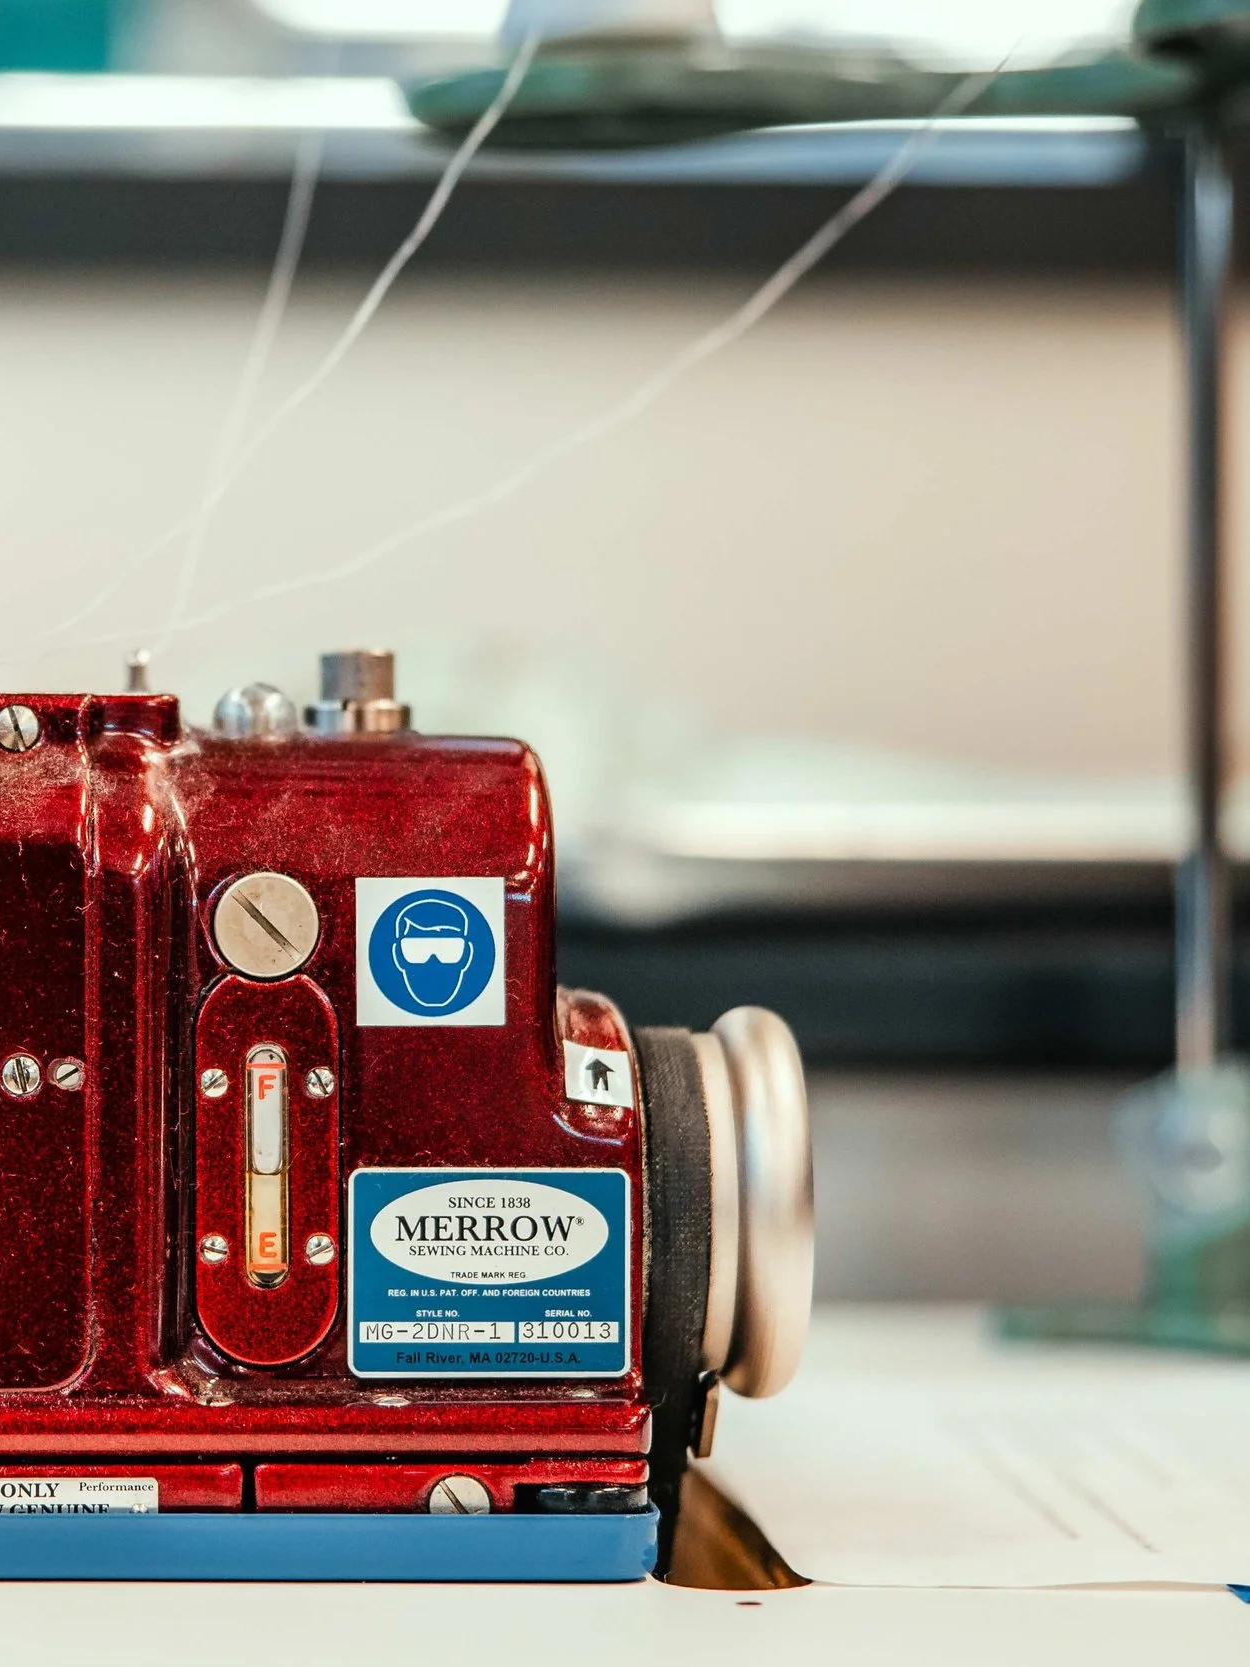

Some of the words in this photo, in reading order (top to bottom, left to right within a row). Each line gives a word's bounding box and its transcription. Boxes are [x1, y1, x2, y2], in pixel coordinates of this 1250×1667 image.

[258, 1074, 277, 1100] F
[448, 1197, 495, 1208] SINCE
[500, 1197, 531, 1208] 1838
[258, 1232, 278, 1258] E
[409, 1245, 466, 1256] SEWING
[470, 1245, 540, 1256] MACHINE
[544, 1245, 569, 1256] CO.
[450, 1271, 479, 1279] TRADE
[481, 1271, 505, 1279] MARK
[508, 1271, 528, 1279] REG.
[387, 1289, 408, 1297] REG.
[410, 1289, 420, 1297] IN
[421, 1289, 438, 1297] U.S.
[439, 1289, 459, 1297] PAT.
[460, 1289, 480, 1297] OFF.
[482, 1289, 500, 1297] AND
[502, 1289, 540, 1297] FOREIGN
[542, 1289, 591, 1297] COUNTRIES
[415, 1310, 443, 1318] STYLE
[444, 1310, 460, 1318] NO.
[544, 1310, 575, 1318] SERIAL
[577, 1310, 592, 1318] NO.
[365, 1322, 501, 1340] MG-2DNR-1
[522, 1321, 612, 1340] 310013
[396, 1352, 421, 1364] Fall
[426, 1352, 464, 1366] River,
[469, 1352, 491, 1364] MA
[0, 1483, 60, 1498] ONLY
[79, 1481, 154, 1492] Performance
